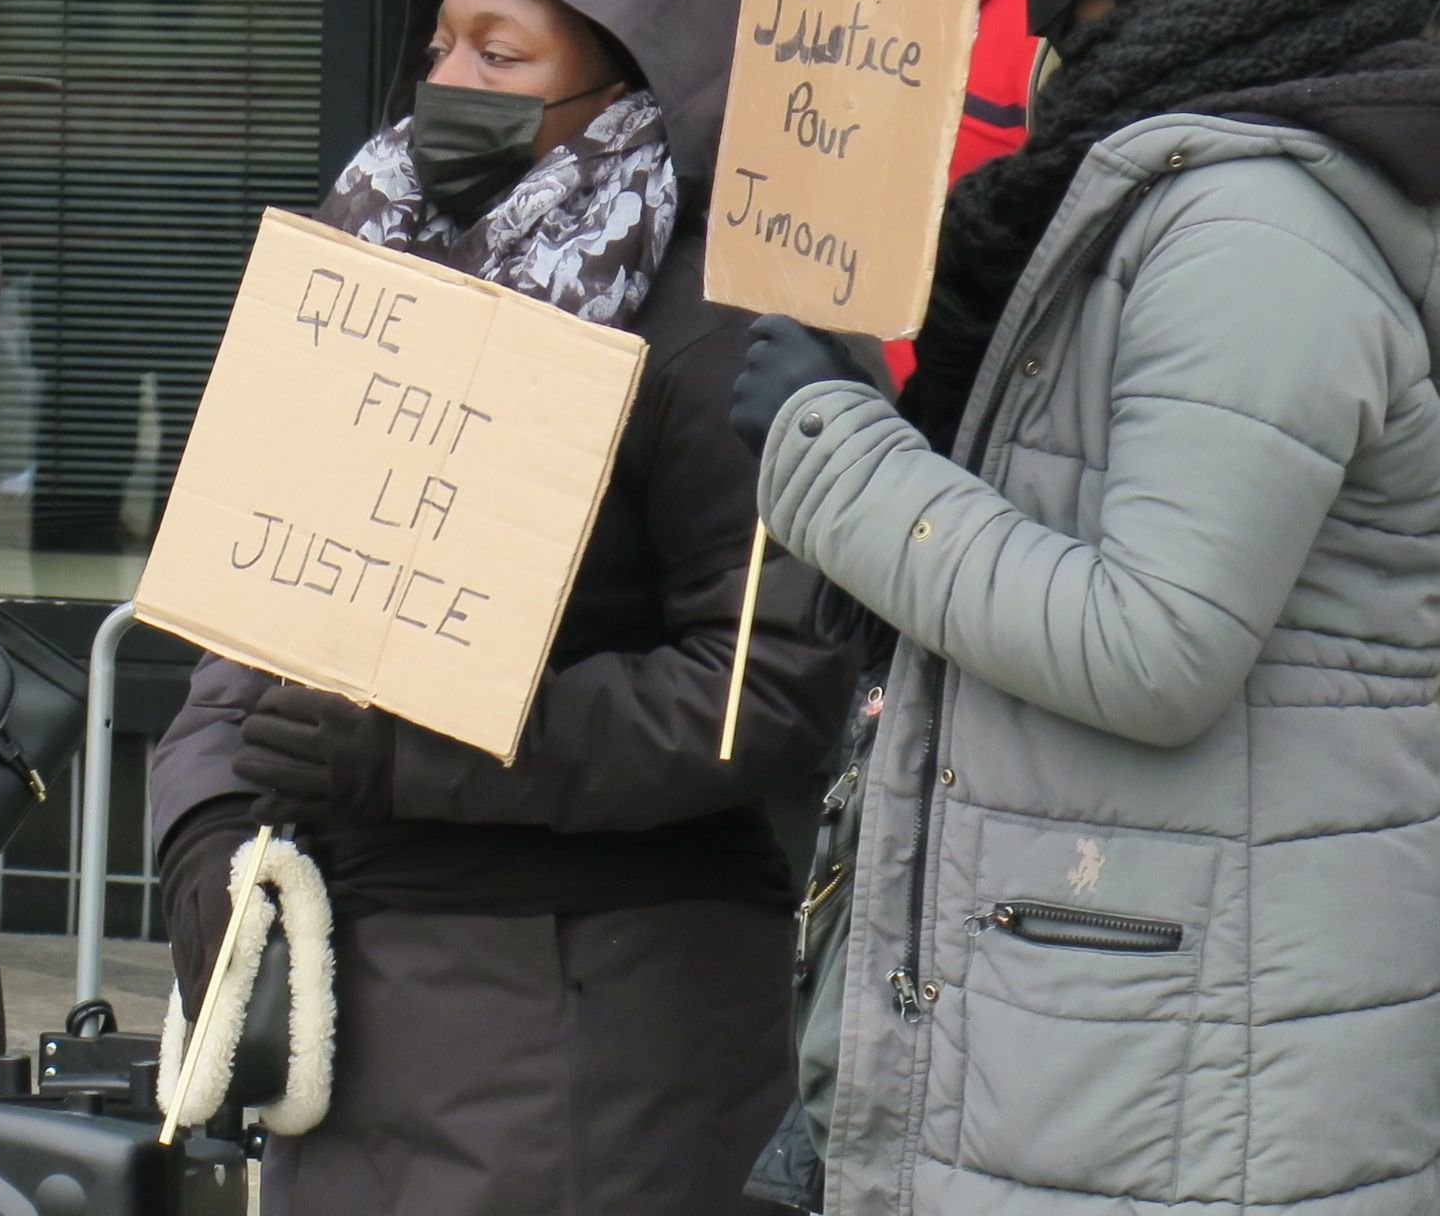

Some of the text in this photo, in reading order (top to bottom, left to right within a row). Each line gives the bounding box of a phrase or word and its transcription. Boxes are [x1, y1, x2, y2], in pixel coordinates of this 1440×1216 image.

[784, 81, 860, 158] Pour
[726, 167, 858, 306] Jimony
[297, 268, 417, 354] QUE
[353, 372, 492, 455] FAIT
[370, 468, 458, 541] LA
[231, 511, 490, 647] JUSTICE
